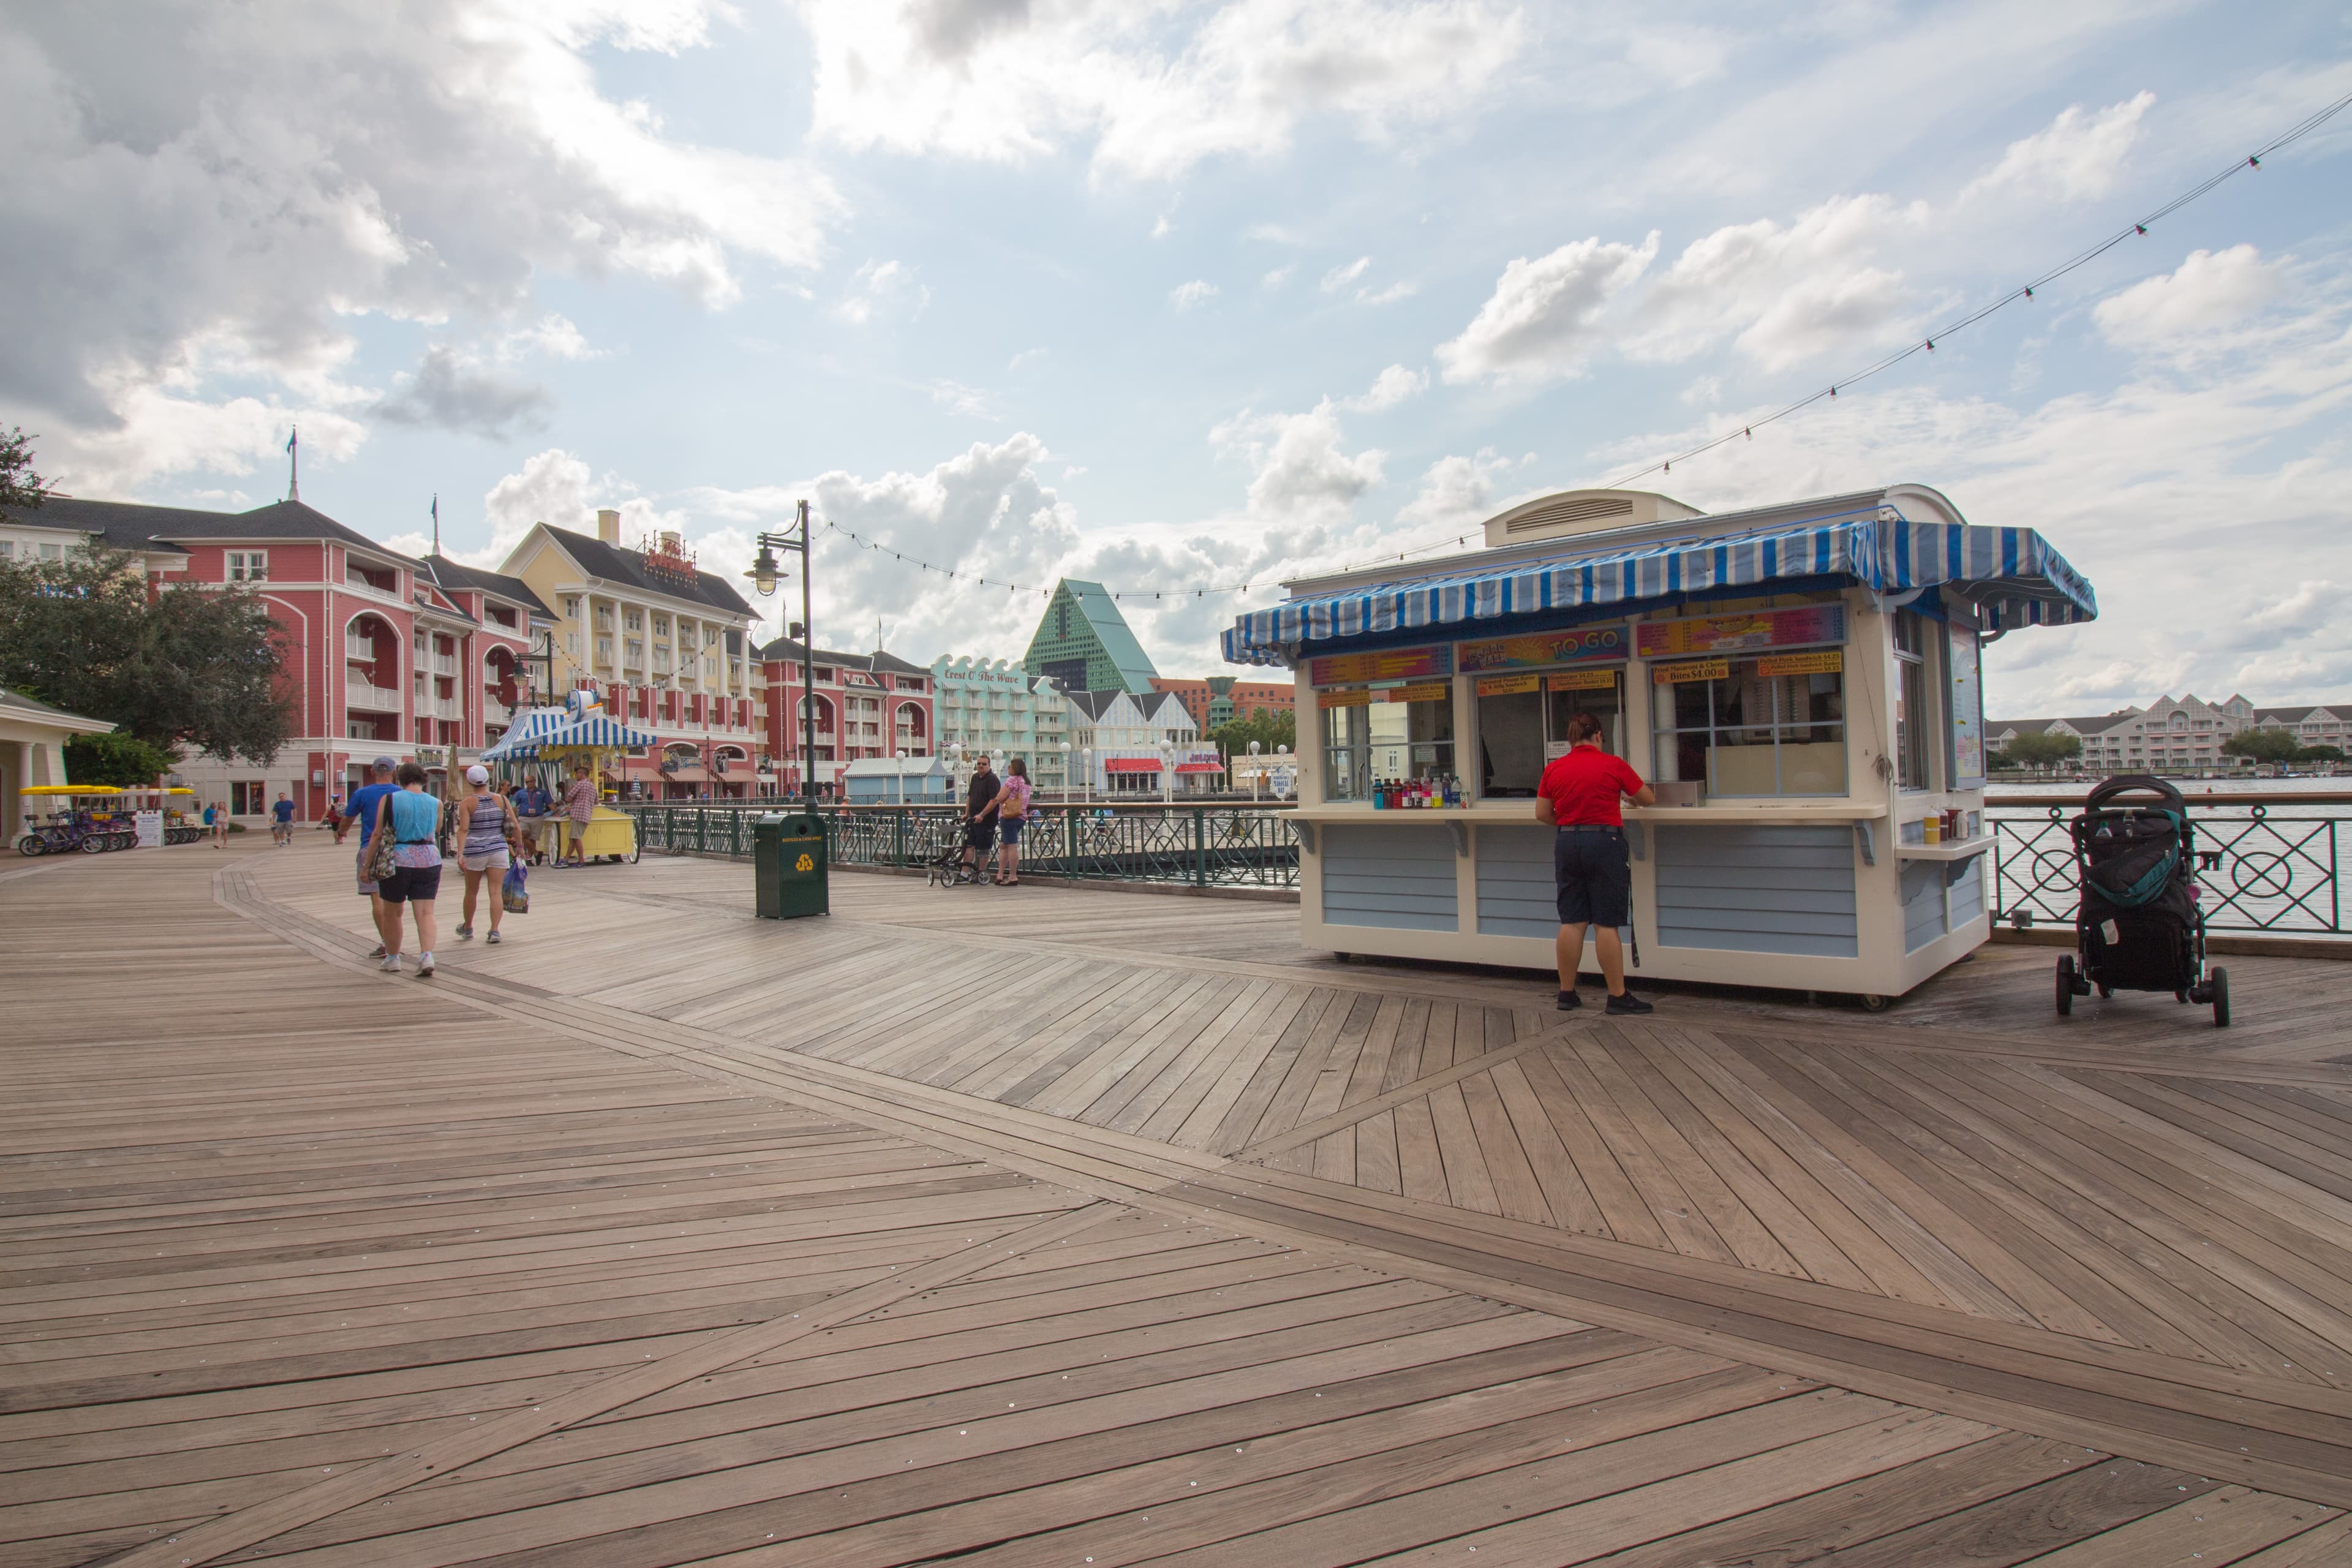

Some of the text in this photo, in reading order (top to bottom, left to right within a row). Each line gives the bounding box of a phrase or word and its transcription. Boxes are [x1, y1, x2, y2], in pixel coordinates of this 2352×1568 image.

[1549, 638, 1579, 660] TO
[1585, 631, 1618, 649] GO
[944, 668, 966, 679] Crest
[978, 671, 994, 682] The
[997, 673, 1019, 684] Wave
[1691, 668, 1716, 678] $4.00
